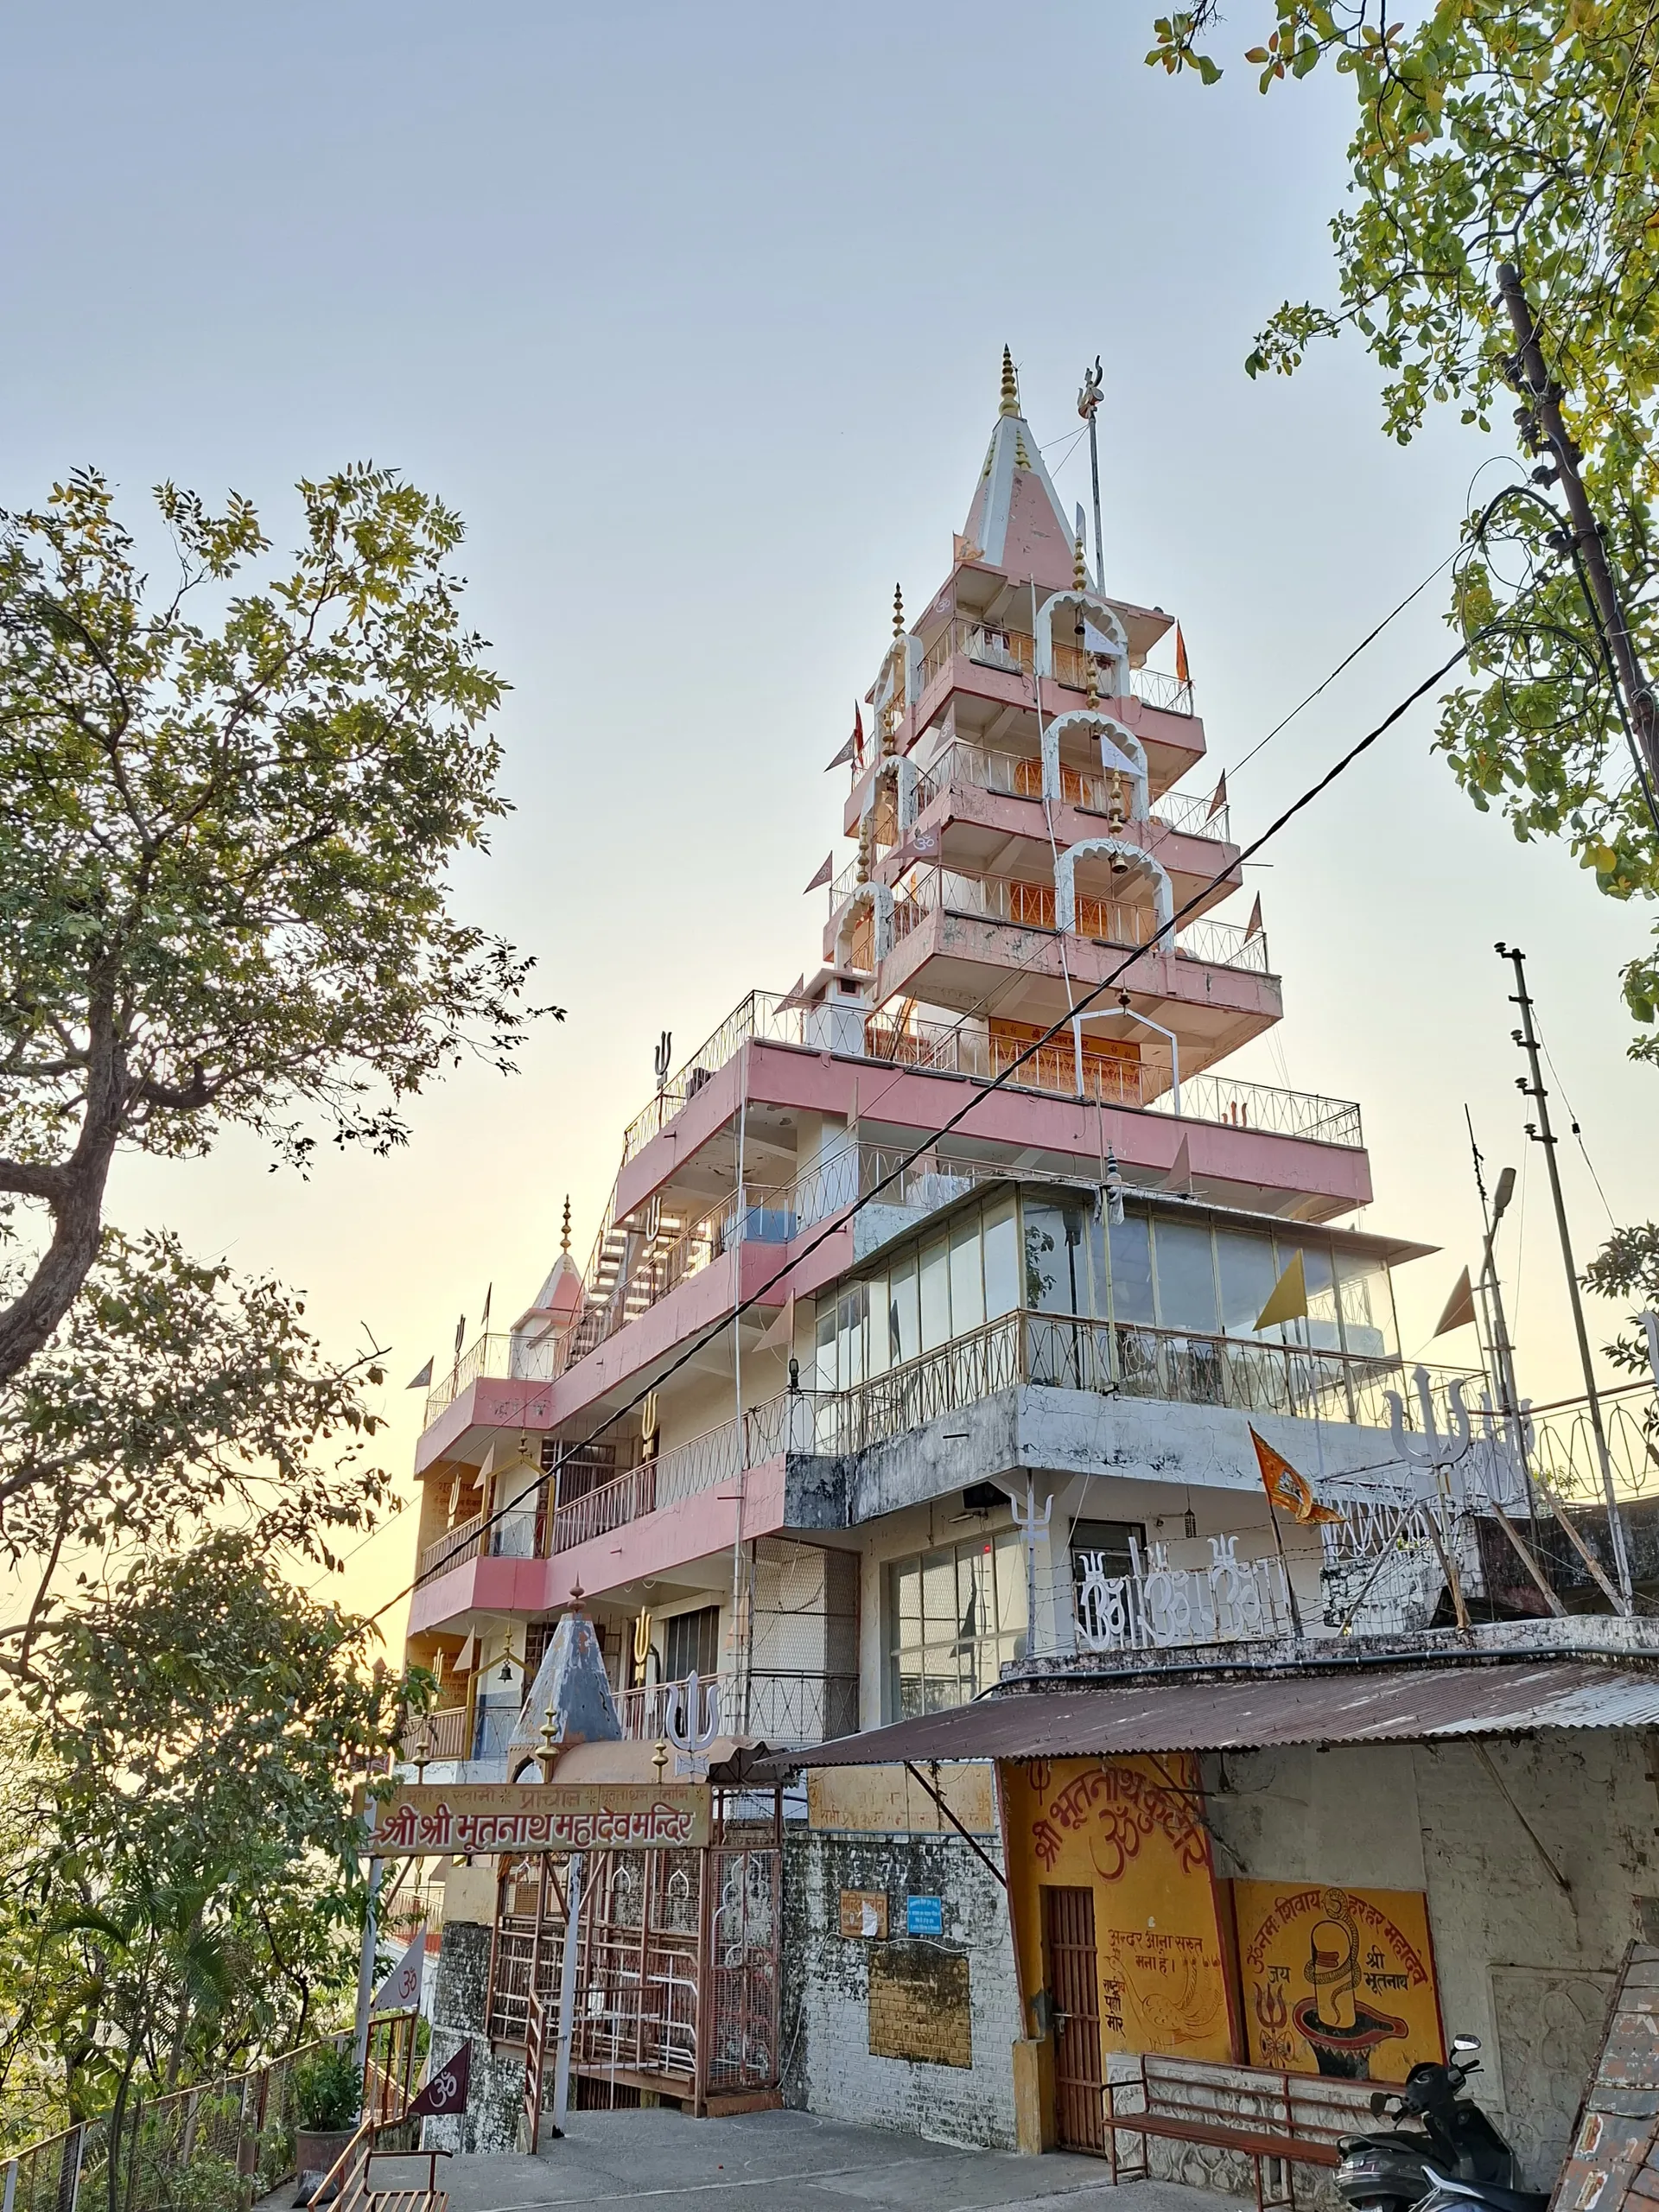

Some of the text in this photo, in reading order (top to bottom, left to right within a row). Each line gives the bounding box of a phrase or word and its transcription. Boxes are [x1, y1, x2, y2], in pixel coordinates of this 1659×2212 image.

[519, 1786, 582, 1809] प्राचीन
[378, 1802, 696, 1852] श्री श्री भूतनाथ महादेव मन्दिर
[1032, 1819, 1064, 1872] श्री
[1049, 1766, 1147, 1831] भूतनाथ
[1108, 1929, 1142, 1952] अन्दर
[1146, 1930, 1173, 1950] आना
[1274, 1890, 1321, 1923] शिवाय
[1347, 1894, 1367, 1923] हर
[1365, 1904, 1386, 1934] हर
[1383, 1920, 1428, 1986] महादेव
[1135, 1955, 1156, 1971] मना
[1365, 1945, 1385, 1969] श्री
[1267, 1965, 1291, 1984] जय
[1363, 1972, 1409, 1997] भूतनाथ
[1105, 2012, 1126, 2038] मोर
